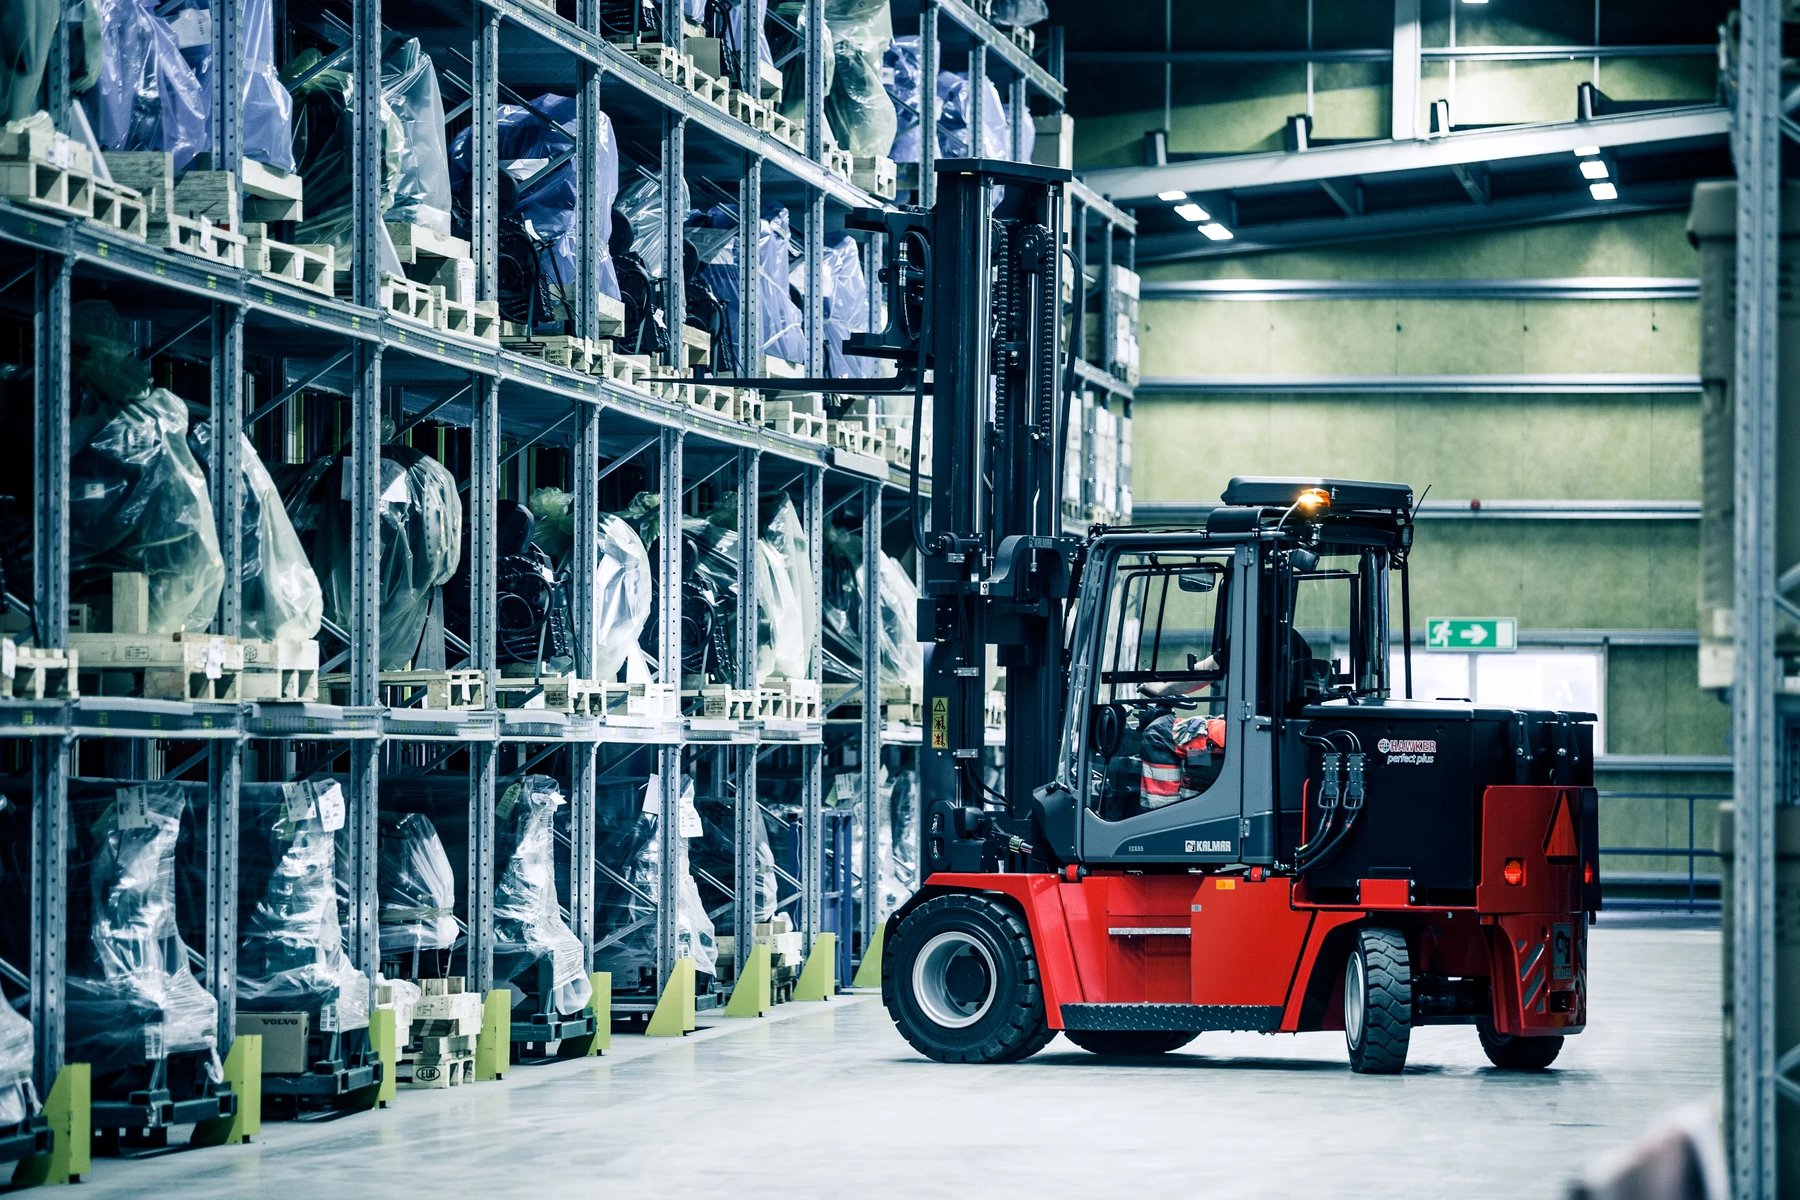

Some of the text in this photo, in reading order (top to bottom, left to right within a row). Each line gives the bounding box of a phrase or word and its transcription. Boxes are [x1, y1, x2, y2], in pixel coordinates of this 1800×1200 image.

[1390, 740, 1436, 752] HAWKER
[1387, 753, 1434, 765] perfect plus
[1196, 840, 1231, 852] KALMAR
[421, 1068, 436, 1078] EUR
